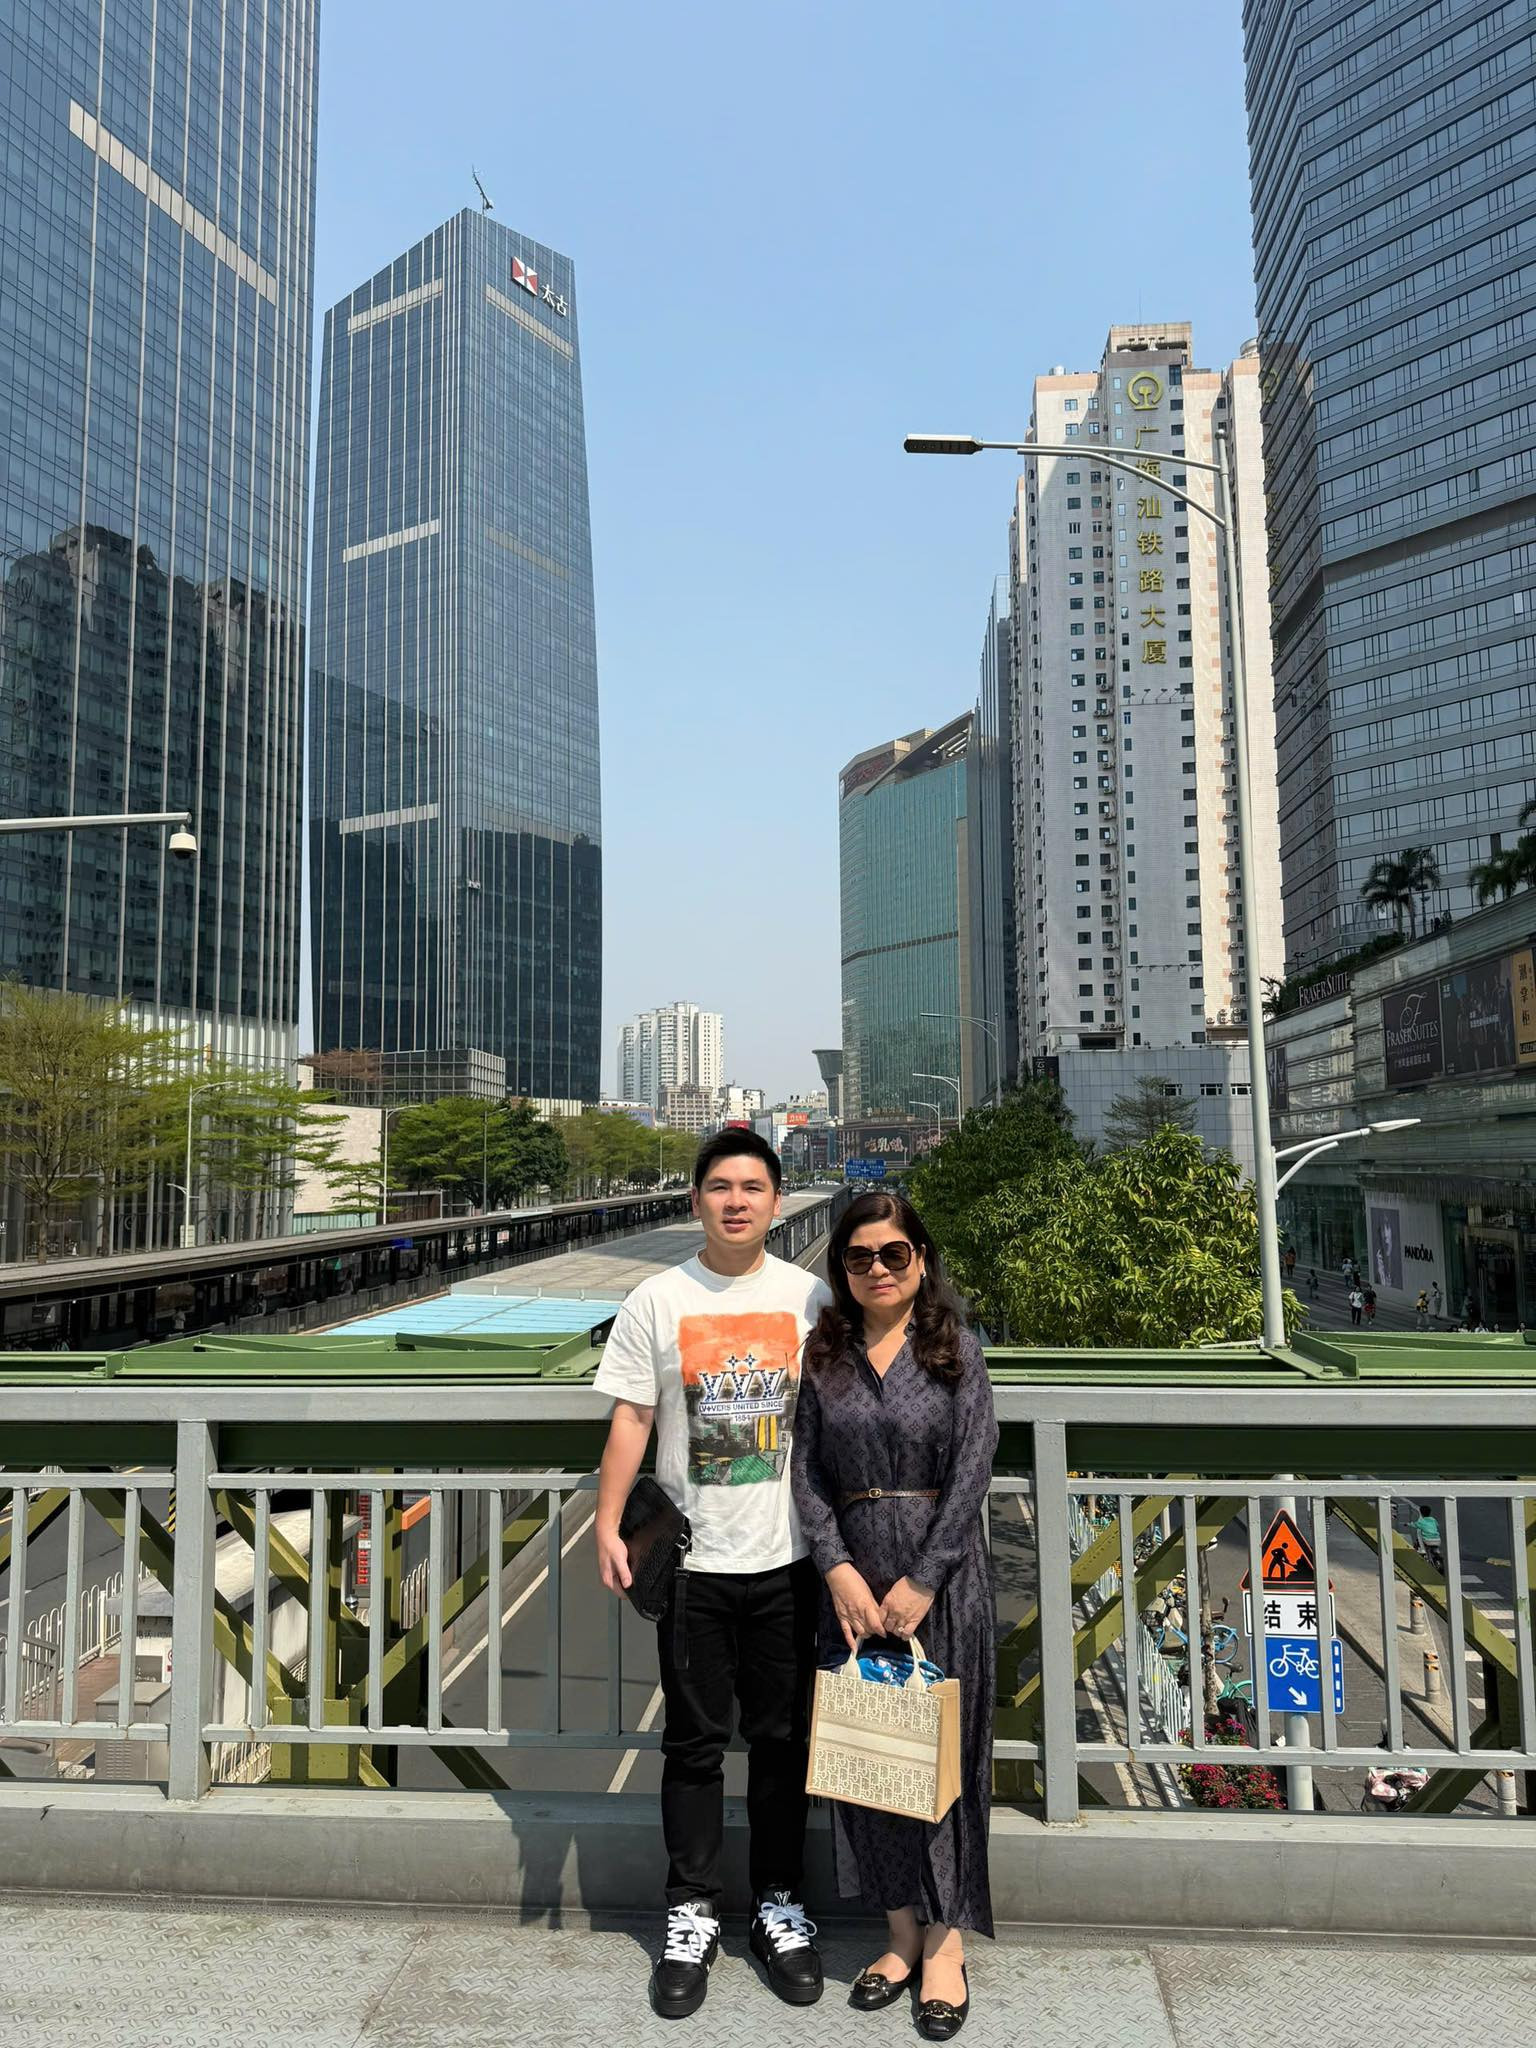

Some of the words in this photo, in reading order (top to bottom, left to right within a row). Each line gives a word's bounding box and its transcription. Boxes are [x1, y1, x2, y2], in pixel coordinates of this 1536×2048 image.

[541, 284, 568, 317] 太古
[733, 1402, 760, 1410] UNITED
[761, 1400, 784, 1408] SINCE
[1263, 1599, 1318, 1630] 结束
